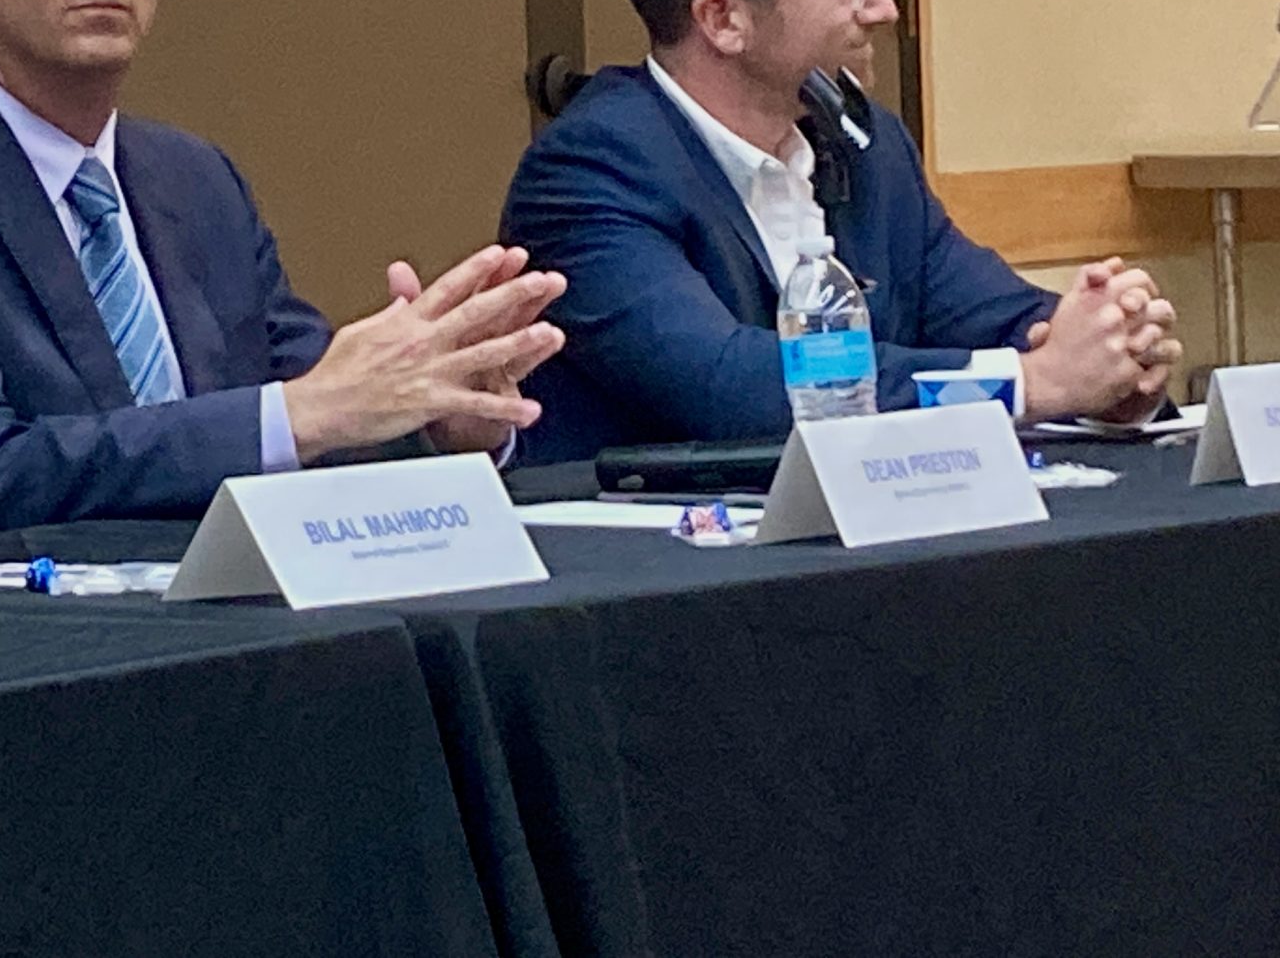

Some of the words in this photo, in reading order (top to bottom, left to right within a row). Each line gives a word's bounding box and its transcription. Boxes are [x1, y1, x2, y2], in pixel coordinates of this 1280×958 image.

[862, 459, 908, 482] DEAN
[908, 448, 981, 475] PRESTON
[303, 518, 365, 545] BILAL
[364, 504, 470, 538] MAHMOOD
